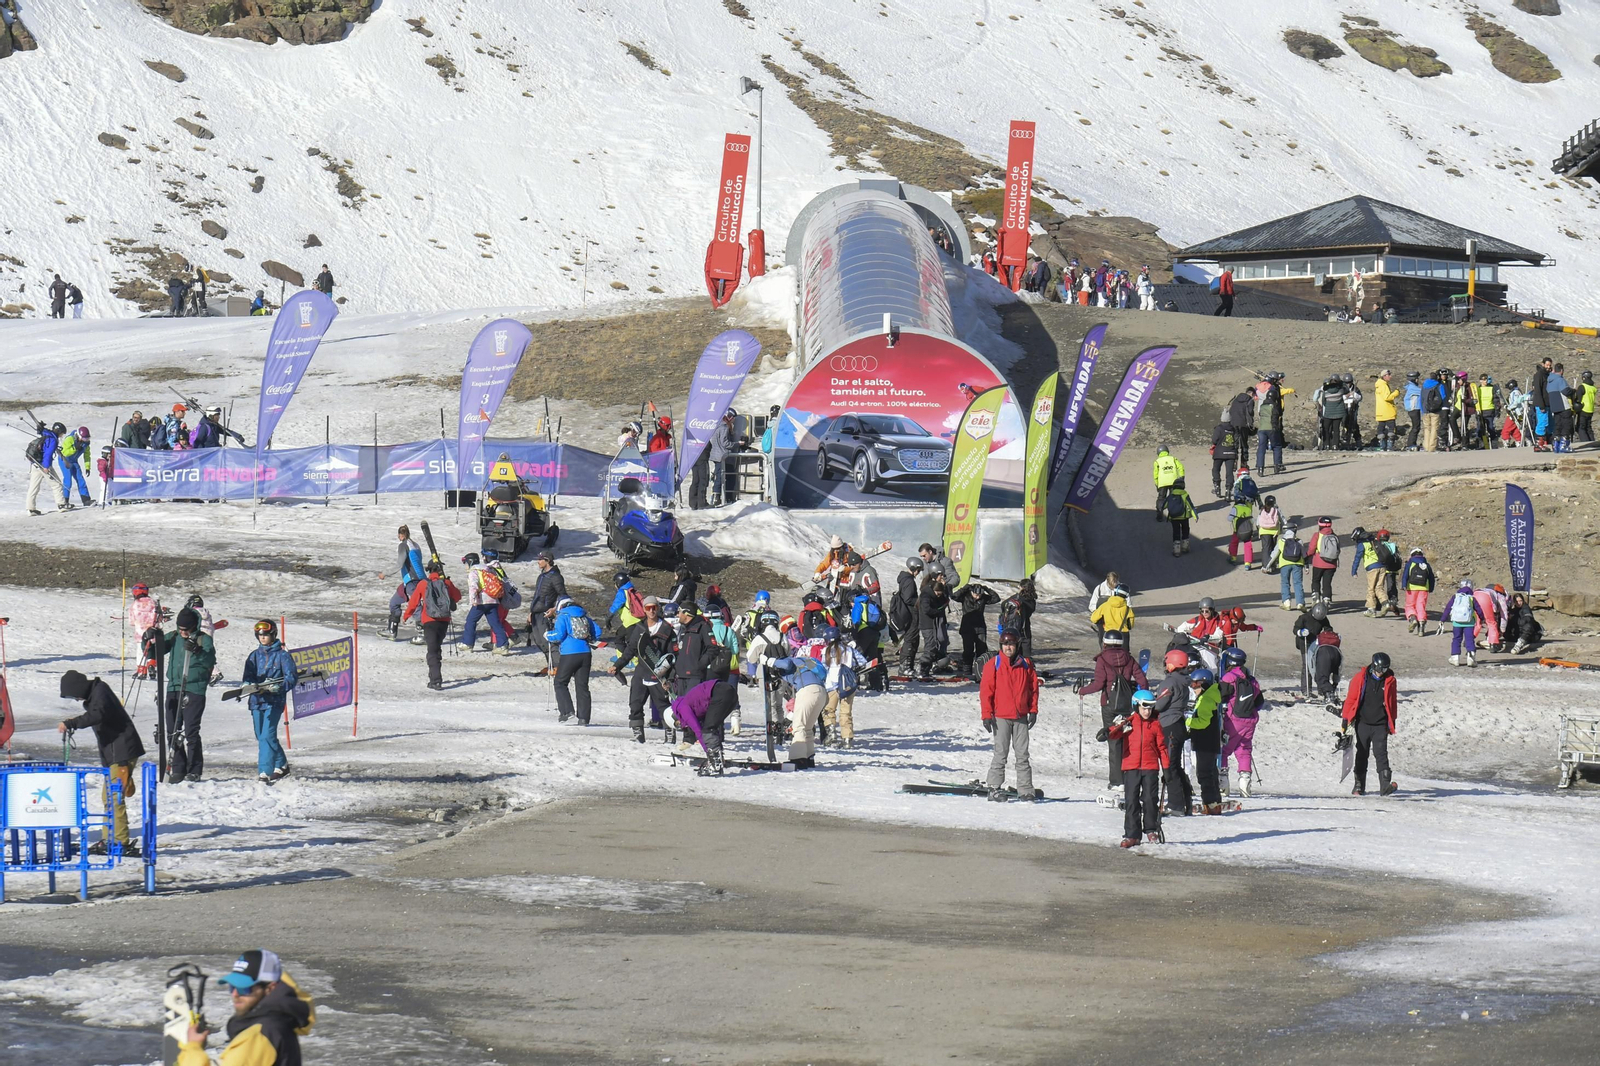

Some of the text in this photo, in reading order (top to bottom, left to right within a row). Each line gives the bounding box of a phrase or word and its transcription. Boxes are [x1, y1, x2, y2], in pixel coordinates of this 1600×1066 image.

[1006, 166, 1020, 229] Circuito de
[1018, 161, 1030, 230] conducción
[718, 179, 734, 242] Circuito de
[729, 175, 744, 243] conducción
[1084, 343, 1098, 359] VIP
[284, 364, 292, 375] 4
[1134, 361, 1160, 380] VIP
[831, 378, 893, 387] Dar el salto,
[831, 388, 926, 396] también al futuro.
[480, 394, 490, 404] 3
[708, 402, 716, 412] 1
[1076, 379, 1150, 498] SIERRA NEVADA
[429, 456, 484, 475] siea
[951, 444, 987, 494] internacional
[954, 446, 978, 477] escuela
[146, 464, 277, 482] sierra nevada
[961, 456, 986, 490] de esquí
[291, 641, 350, 666] DESCENSO
